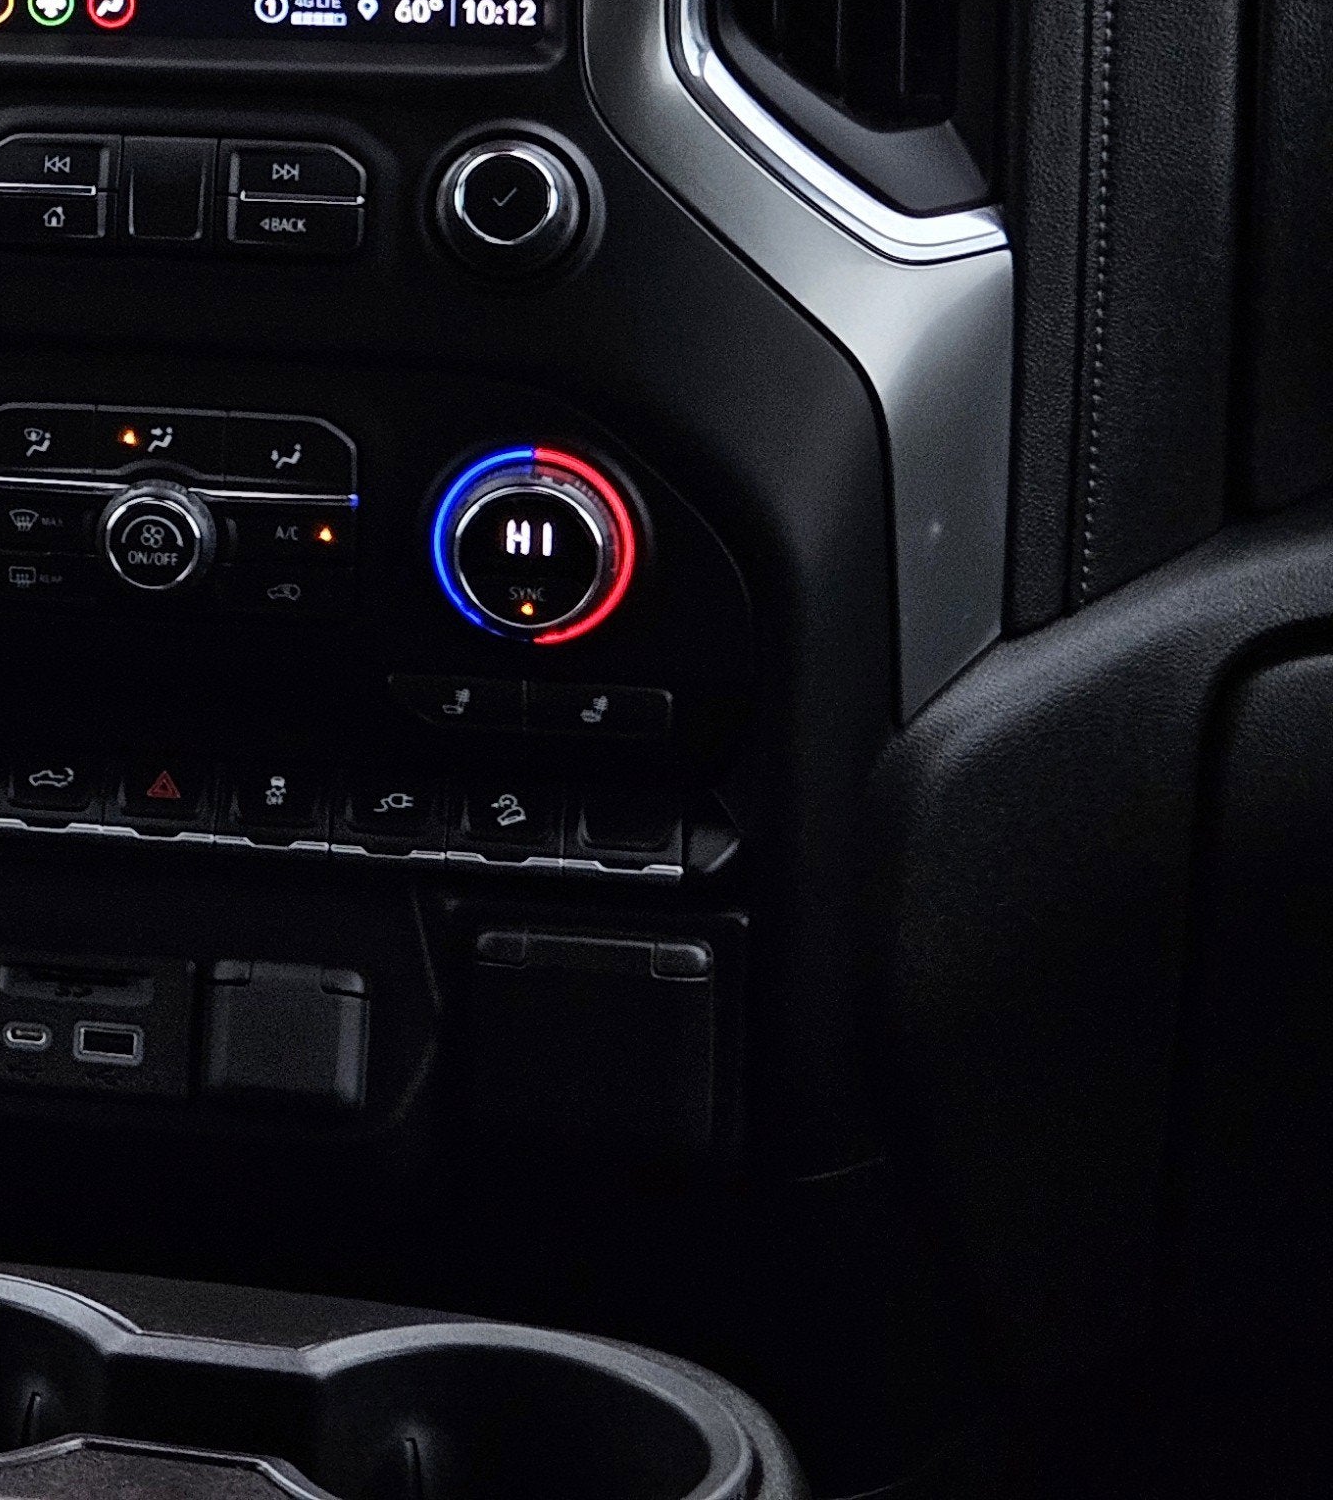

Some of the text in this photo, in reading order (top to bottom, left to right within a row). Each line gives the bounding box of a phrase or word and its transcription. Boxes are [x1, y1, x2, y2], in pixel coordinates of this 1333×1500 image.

[270, 217, 307, 233] BACK
[275, 526, 300, 542] A/C
[505, 518, 554, 558] HI
[128, 551, 180, 567] ON/OFF
[508, 587, 548, 601] SYNC
